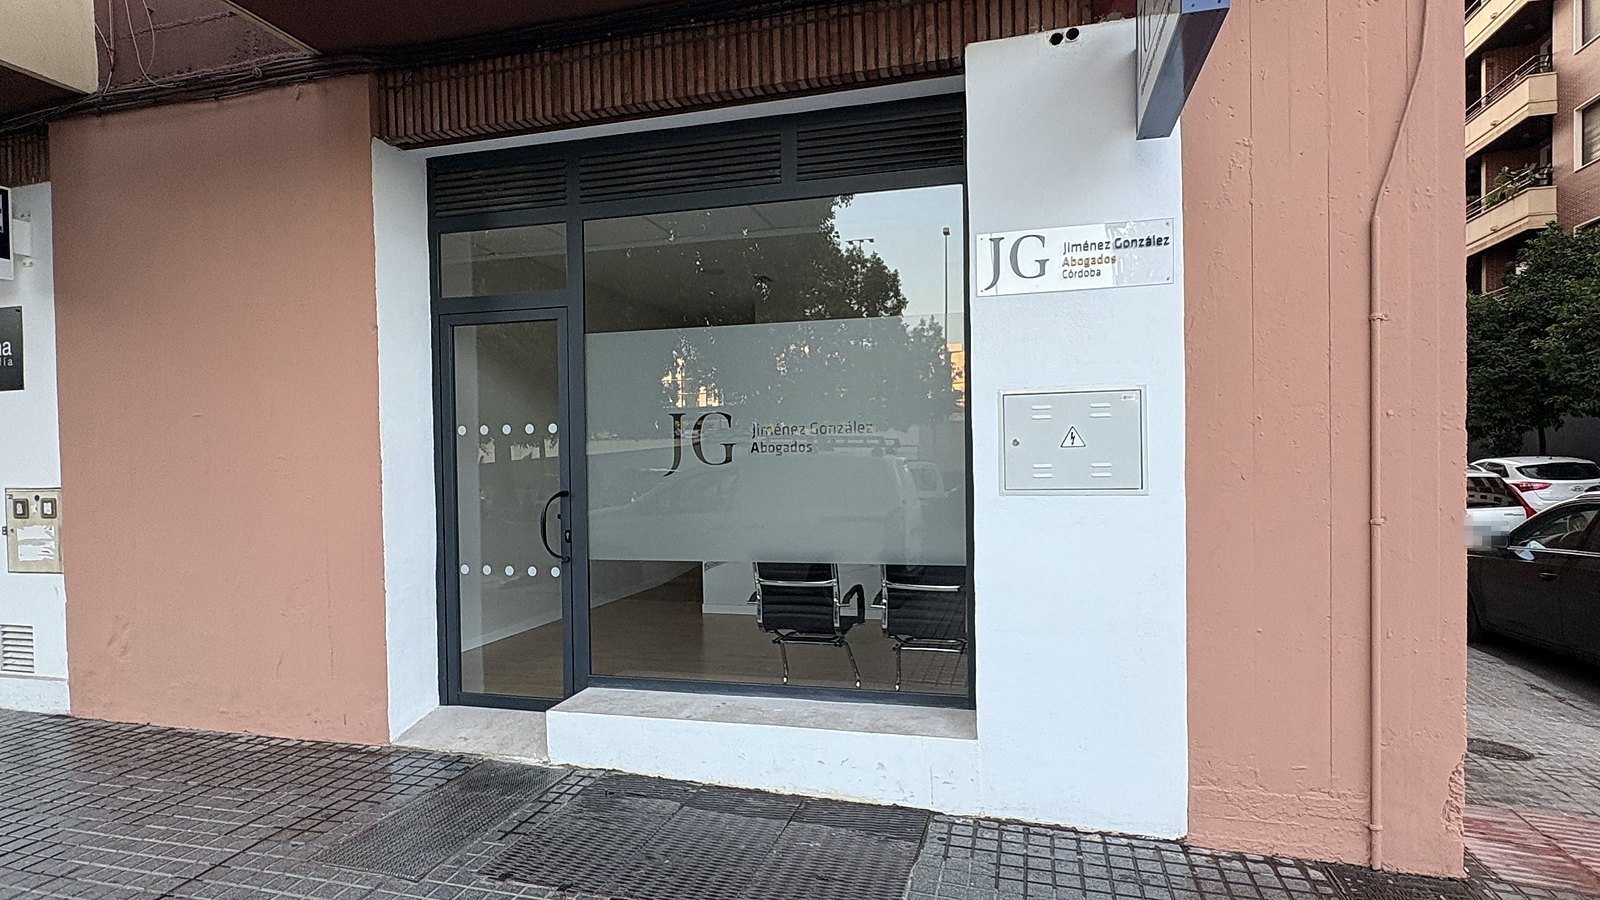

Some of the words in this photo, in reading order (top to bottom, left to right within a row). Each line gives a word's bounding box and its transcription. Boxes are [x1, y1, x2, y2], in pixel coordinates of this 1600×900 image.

[1063, 239, 1111, 255] Jiménez
[1114, 234, 1170, 250] González
[984, 234, 1050, 291] JG
[1062, 254, 1117, 269] Abogados
[1062, 267, 1101, 279] Córdoba
[0, 341, 12, 356] a
[752, 422, 806, 439] Jiménez
[810, 420, 873, 435] González
[663, 411, 737, 477] JG
[750, 440, 813, 456] Abogados
